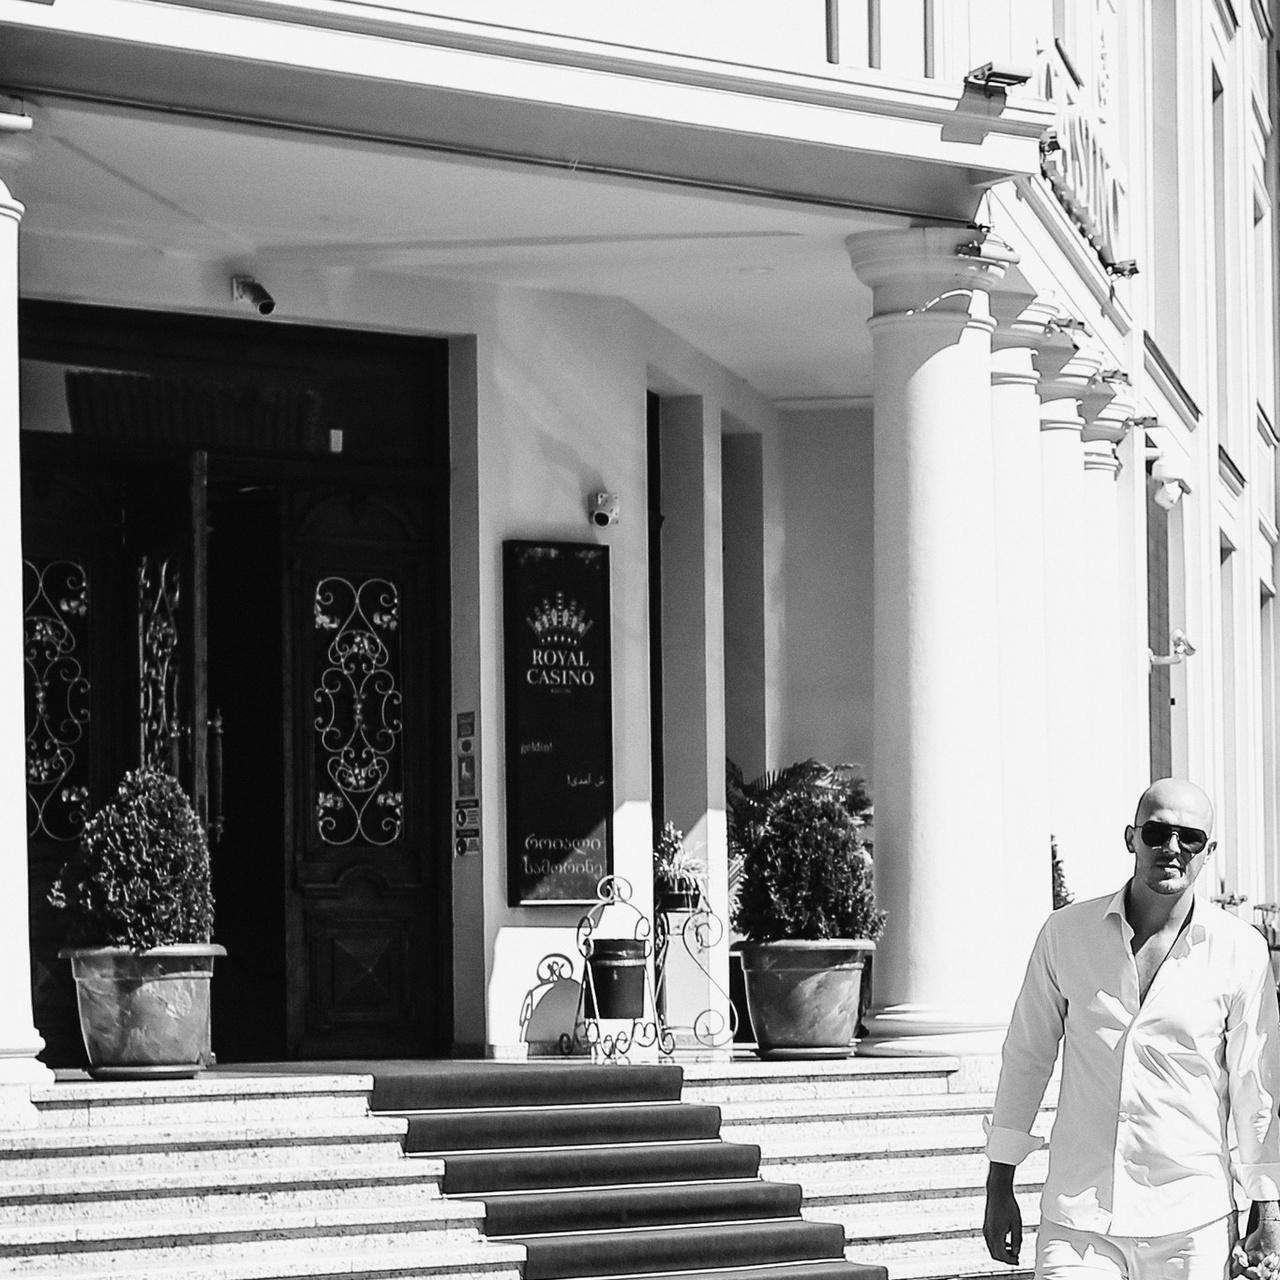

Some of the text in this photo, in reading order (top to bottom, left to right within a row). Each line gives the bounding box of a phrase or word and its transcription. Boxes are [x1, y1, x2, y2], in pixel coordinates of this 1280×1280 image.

[532, 649, 590, 667] ROYAL
[526, 668, 595, 687] CASINO
[524, 832, 602, 856] როიალი
